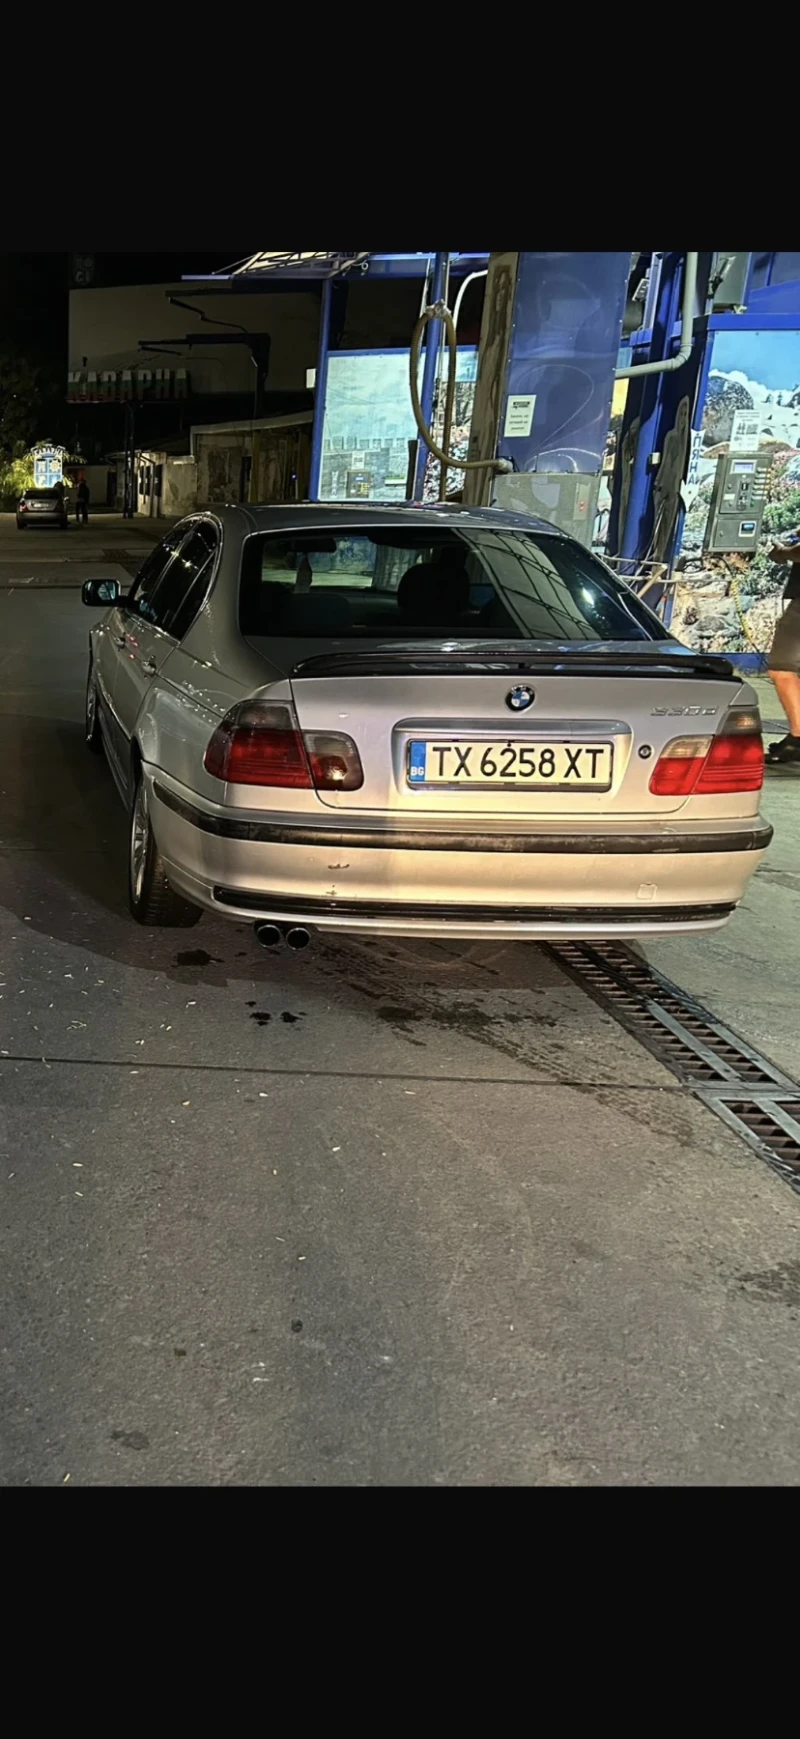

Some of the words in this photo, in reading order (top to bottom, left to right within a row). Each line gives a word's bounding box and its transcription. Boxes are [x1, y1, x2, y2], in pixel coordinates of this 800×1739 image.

[688, 436, 702, 484] ПЯНА
[410, 766, 425, 776] BG
[432, 747, 473, 777] TX
[480, 747, 556, 778] 6258
[564, 748, 604, 778] XT
